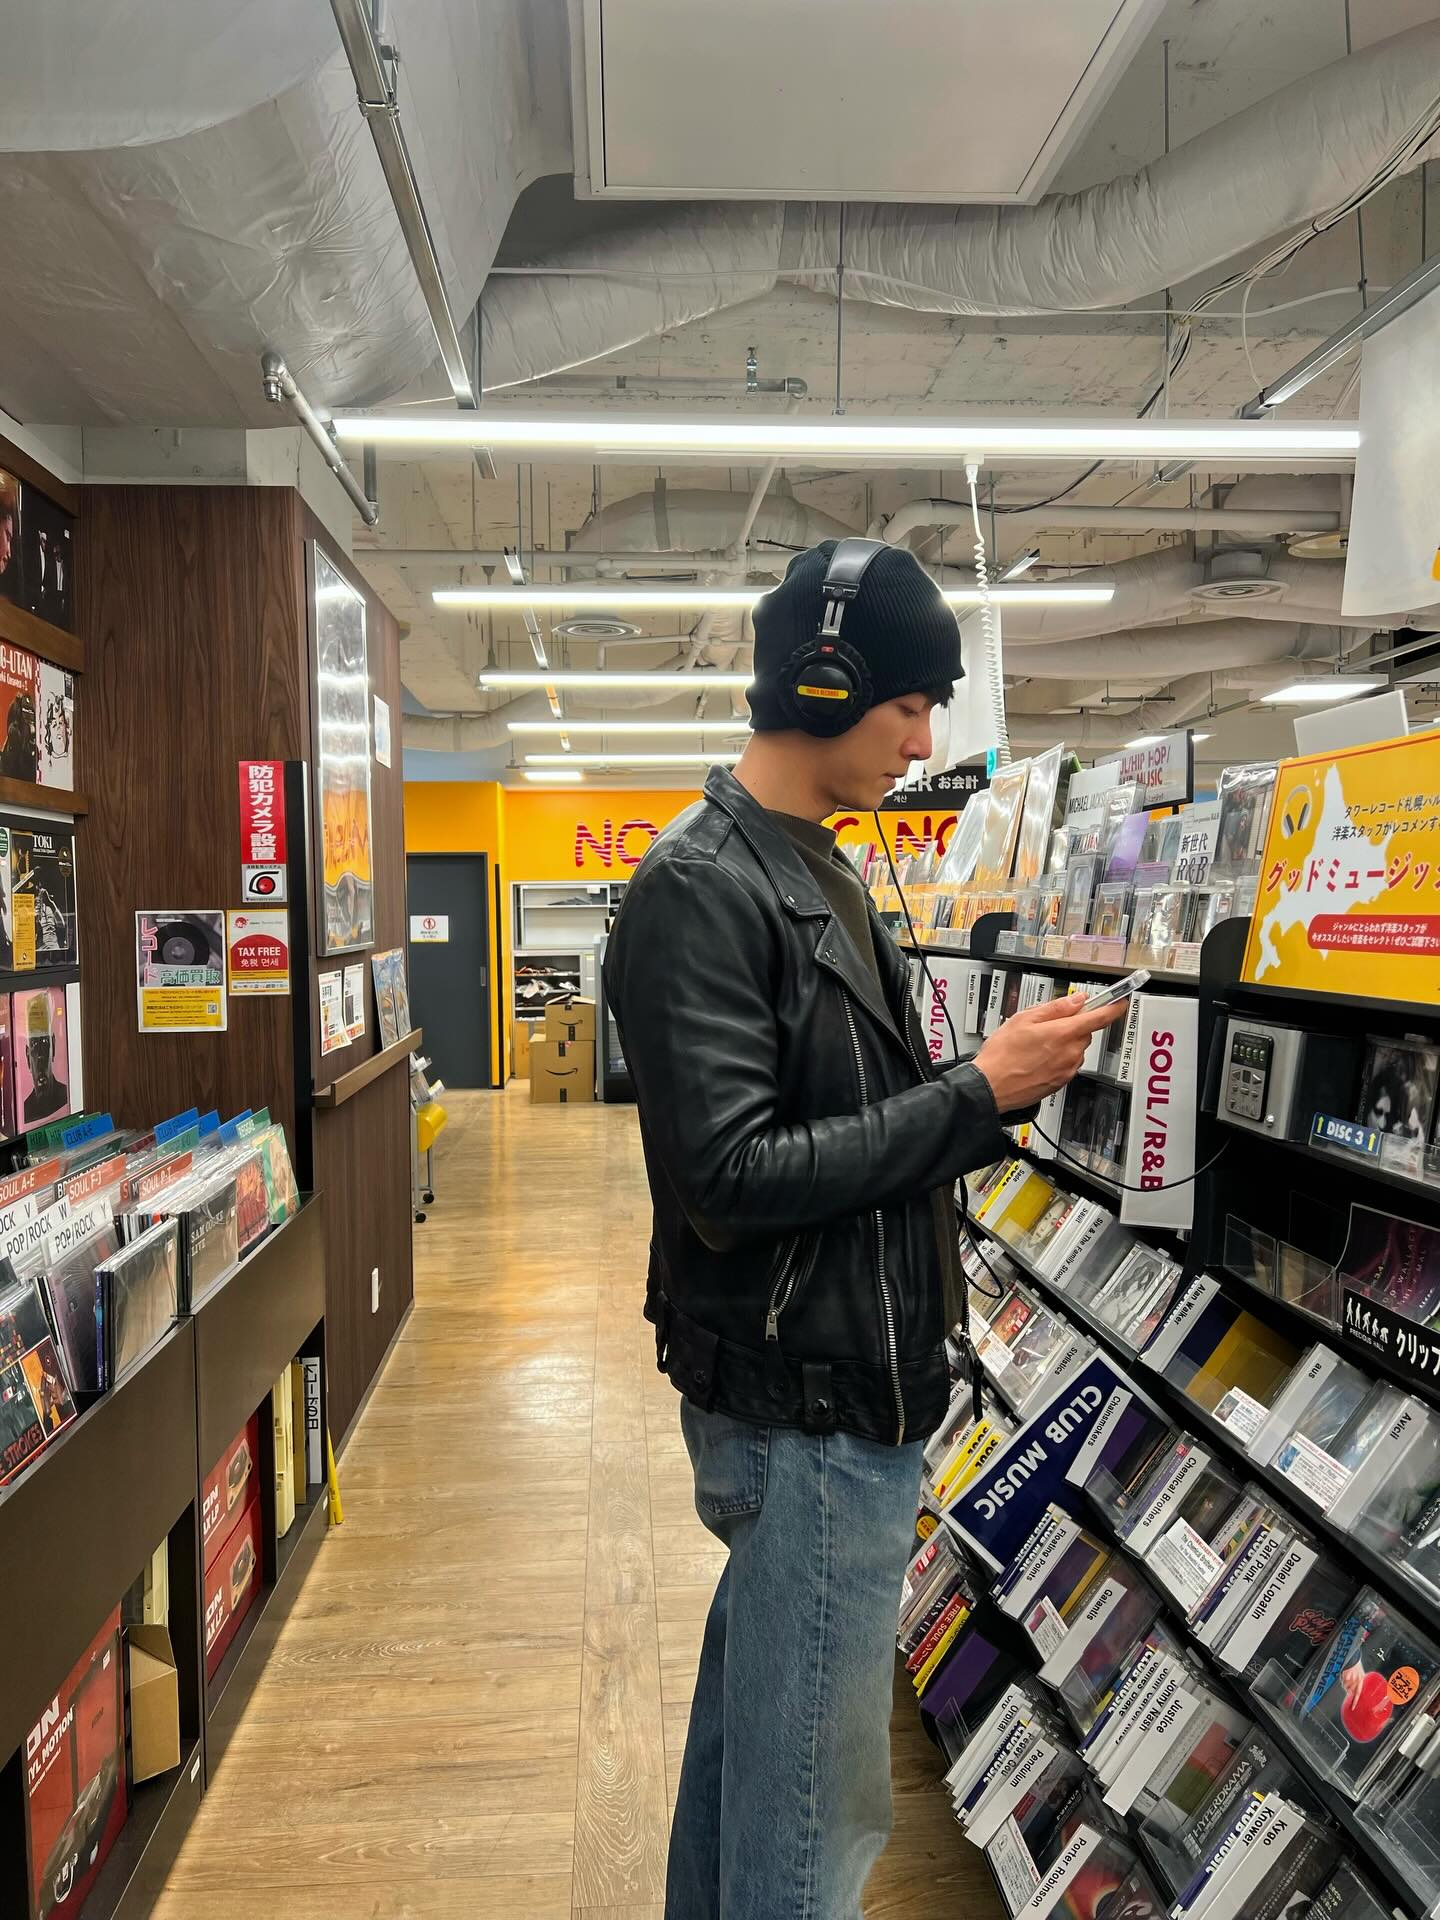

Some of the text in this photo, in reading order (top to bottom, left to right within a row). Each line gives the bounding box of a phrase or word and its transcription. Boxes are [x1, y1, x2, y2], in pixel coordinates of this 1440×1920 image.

[938, 775, 979, 790] お会計
[248, 765, 277, 861] 防犯カメラ設置
[574, 819, 659, 868] NO
[1181, 831, 1209, 855] 新世代
[1332, 816, 1440, 842] 洋楽スタッフがレコメンす
[1265, 852, 1440, 896] グッドミュージッ
[237, 946, 281, 957] TAX FREE
[160, 969, 221, 985] 高価買取
[1120, 999, 1139, 1081] NOTHING BUT THE FUNK
[1325, 1121, 1364, 1146] DISC 3
[21, 1172, 36, 1190] A-E
[69, 1177, 90, 1201] SOUL
[142, 1175, 160, 1198] SOUL
[1012, 1169, 1025, 1183] Sade
[24, 1202, 31, 1219] V
[1094, 1217, 1104, 1229] Sly
[6, 1201, 68, 1260] POP/ROCK W
[55, 1201, 108, 1254] POP/ROCK Y
[1079, 1234, 1092, 1247] The
[1066, 1245, 1083, 1266] Family
[1053, 1262, 1069, 1283] Stone
[1192, 1283, 1206, 1302] Alan
[1174, 1298, 1196, 1327] Walker
[1055, 1346, 1078, 1376] Stylistics
[1308, 1362, 1322, 1379] aus
[1087, 1395, 1121, 1447] Chainsmokers
[1390, 1411, 1412, 1441] Avicii
[973, 1384, 1104, 1521] CLUB MUSIC
[1142, 1456, 1197, 1528] Chemical Brothers
[1026, 1527, 1067, 1582] Floating Points
[1257, 1538, 1279, 1564] Daft
[1243, 1561, 1265, 1584] Punk
[1251, 1552, 1301, 1620] Daniel Lopatin
[1086, 1588, 1113, 1621] Galantis
[930, 1603, 961, 1644] FREE SOUL
[1314, 1621, 1351, 1699] SUPREME
[1156, 1679, 1178, 1711] Jonny
[997, 1704, 1019, 1733] Orbital
[1156, 1699, 1183, 1735] Justice
[42, 1705, 74, 1760] MOTION
[1010, 1749, 1044, 1788] Pendulum
[1193, 1759, 1252, 1840] HYPERDRAMA
[1242, 1806, 1275, 1847] Knower
[1262, 1819, 1288, 1846] Kygo
[1061, 1837, 1087, 1868] Porter
[1031, 1868, 1066, 1908] Robinson
